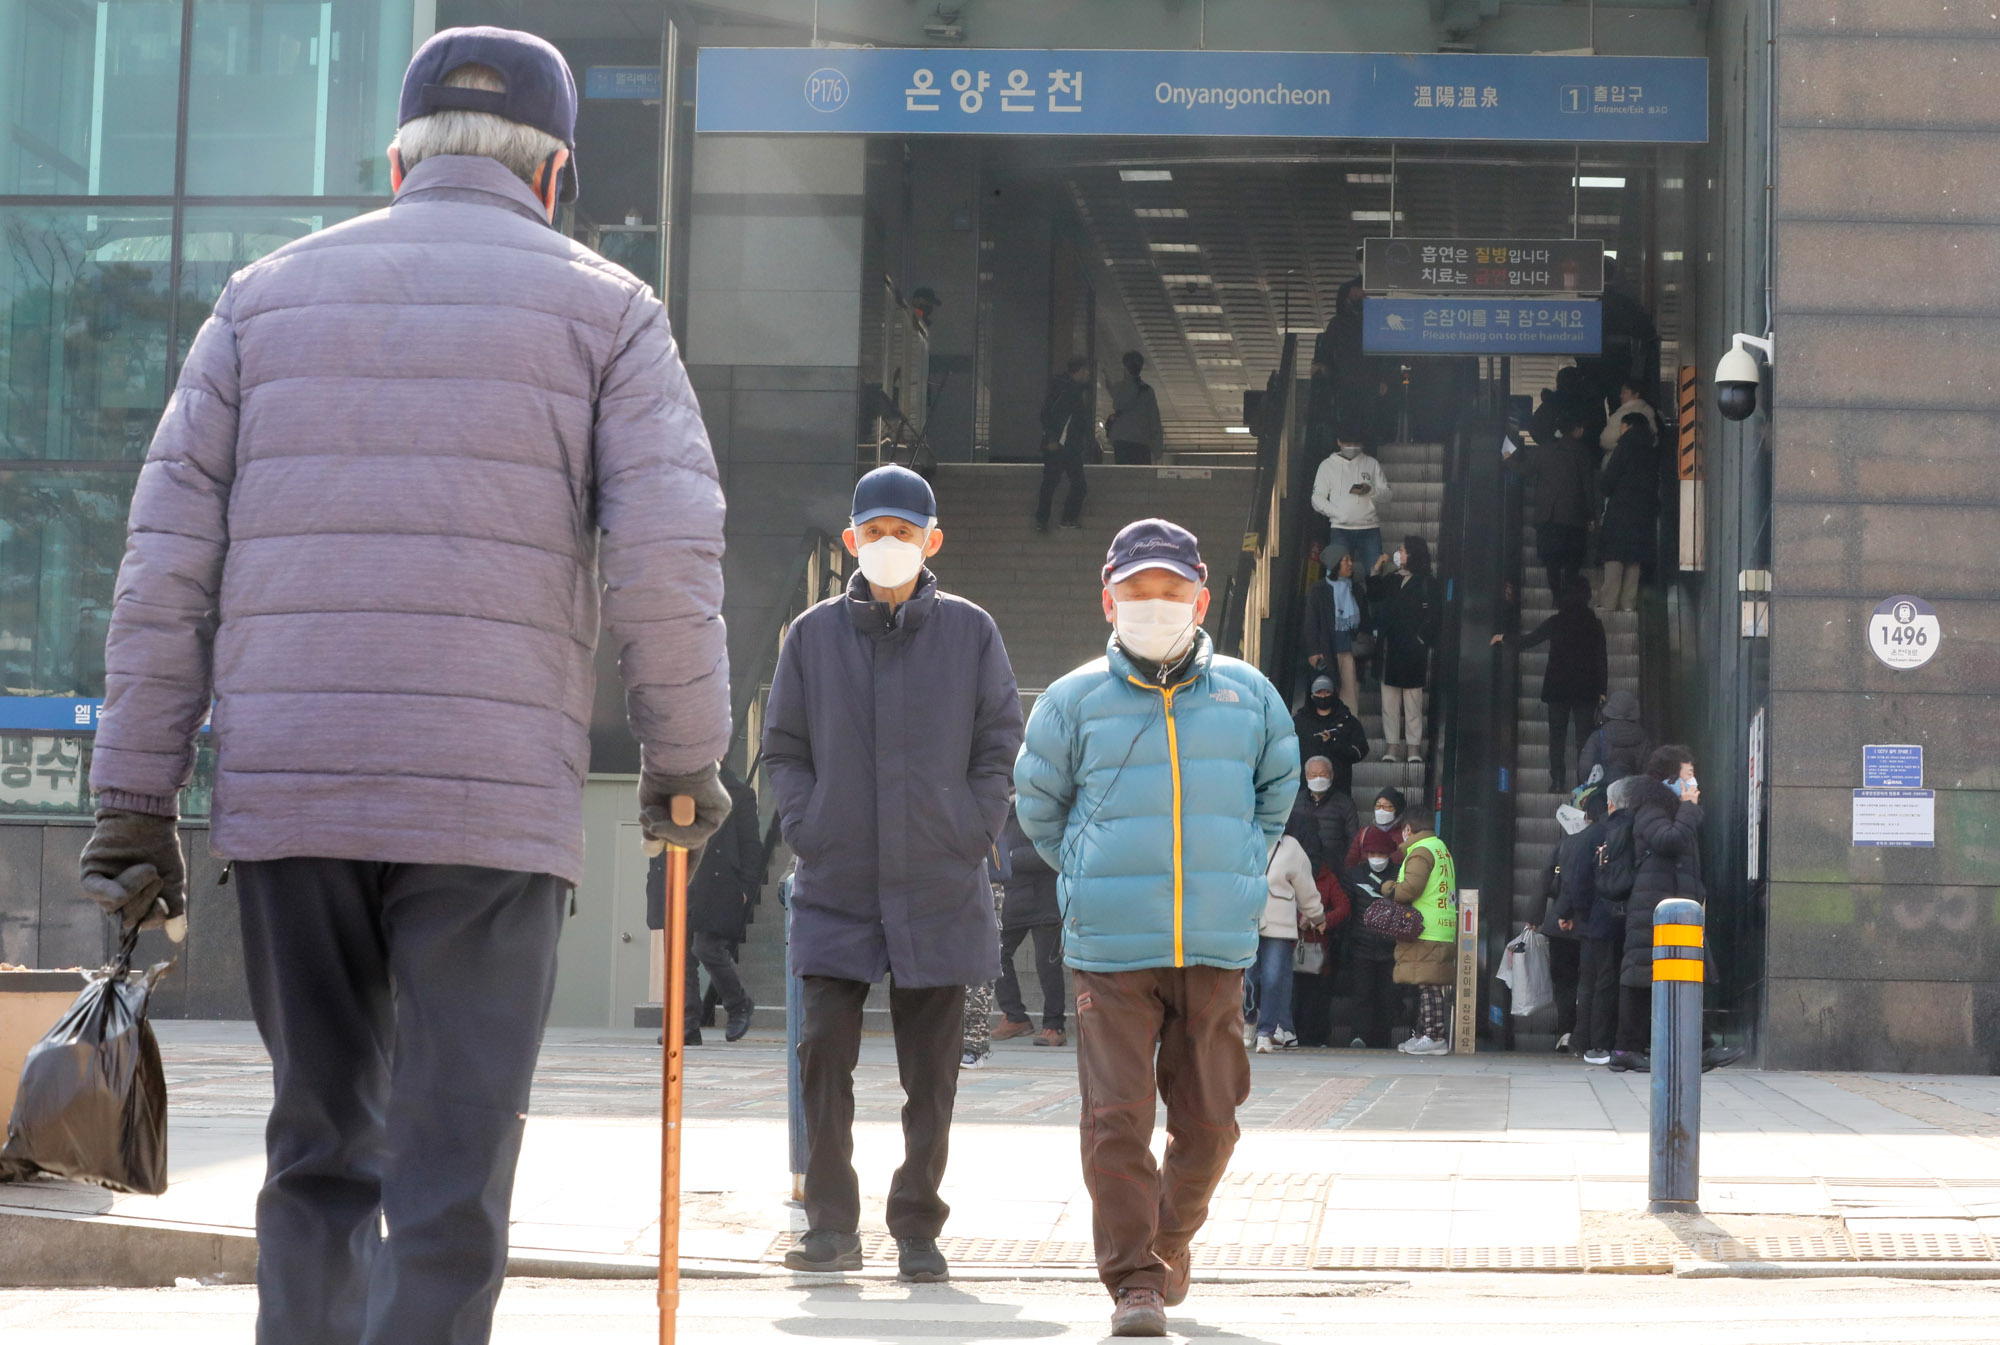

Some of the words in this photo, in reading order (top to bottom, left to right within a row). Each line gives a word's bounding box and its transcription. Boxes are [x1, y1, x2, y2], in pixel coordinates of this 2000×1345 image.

[811, 78, 843, 103] P176
[905, 68, 1083, 114] 온양온천
[1155, 81, 1331, 109] Onyangoncheon
[1413, 85, 1499, 108] 溫陽溫泉
[1569, 88, 1579, 111] 1
[1594, 85, 1643, 102] 출입구
[1594, 104, 1645, 114] Entrance/Exit
[1421, 246, 1468, 264] 흡연은
[1475, 247, 1550, 264] 질병입니다
[1421, 267, 1468, 285] 치료는
[1423, 308, 1487, 327] 손잡이를
[1495, 309, 1511, 328] 꼭
[1519, 309, 1584, 328] 잡으세요
[1422, 330, 1457, 341] Please
[1459, 331, 1486, 343] hang
[1489, 333, 1503, 341] on
[1505, 332, 1517, 341] to
[1519, 331, 1537, 341] the
[1539, 331, 1584, 341] handrail
[1881, 626, 1928, 646] 1496
[1462, 954, 1472, 998] 손잡이를
[1461, 1003, 1472, 1048] 잡으세요
